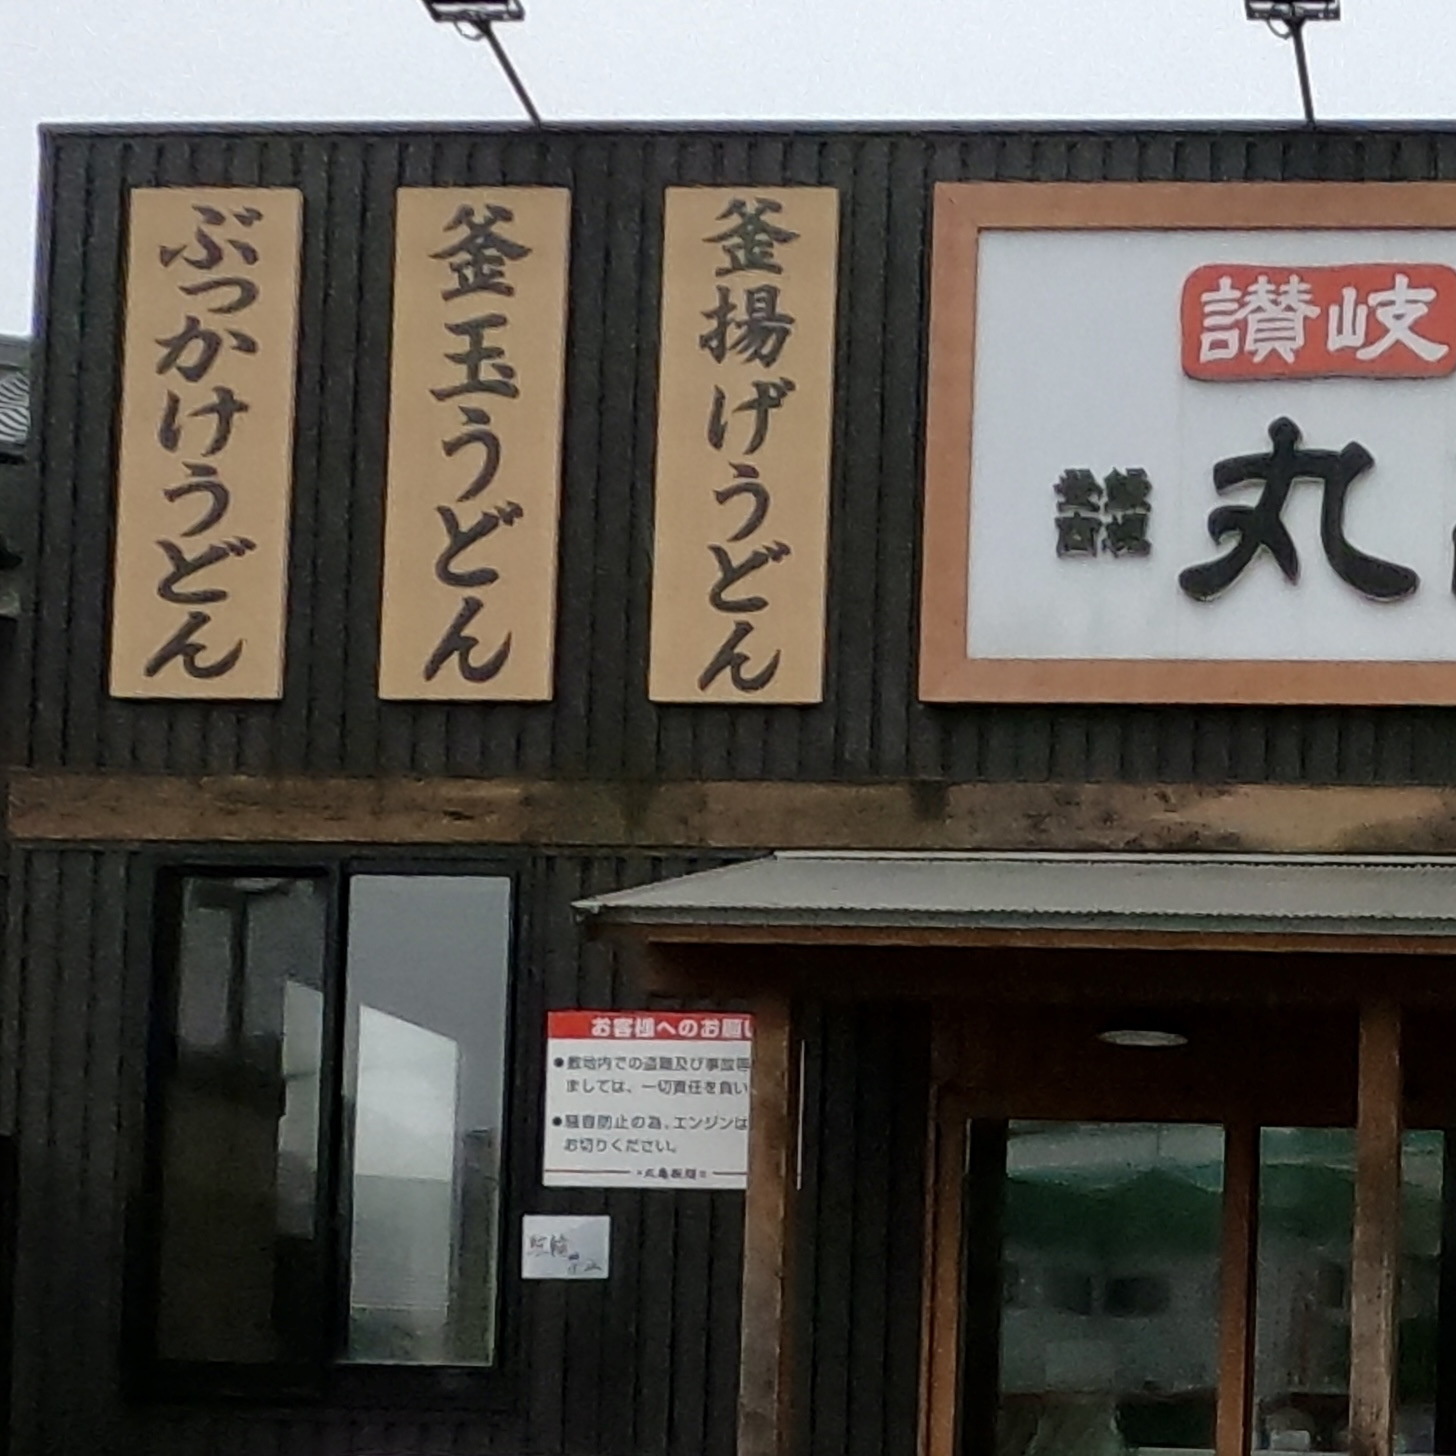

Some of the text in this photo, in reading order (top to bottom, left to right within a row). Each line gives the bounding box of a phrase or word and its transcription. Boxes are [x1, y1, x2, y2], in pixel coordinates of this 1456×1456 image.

[145, 205, 264, 680] ぶっかけうどん
[425, 204, 532, 683] 釜玉うどん
[698, 196, 799, 693] 釜揚げうどん
[1200, 273, 1450, 365] 讃岐
